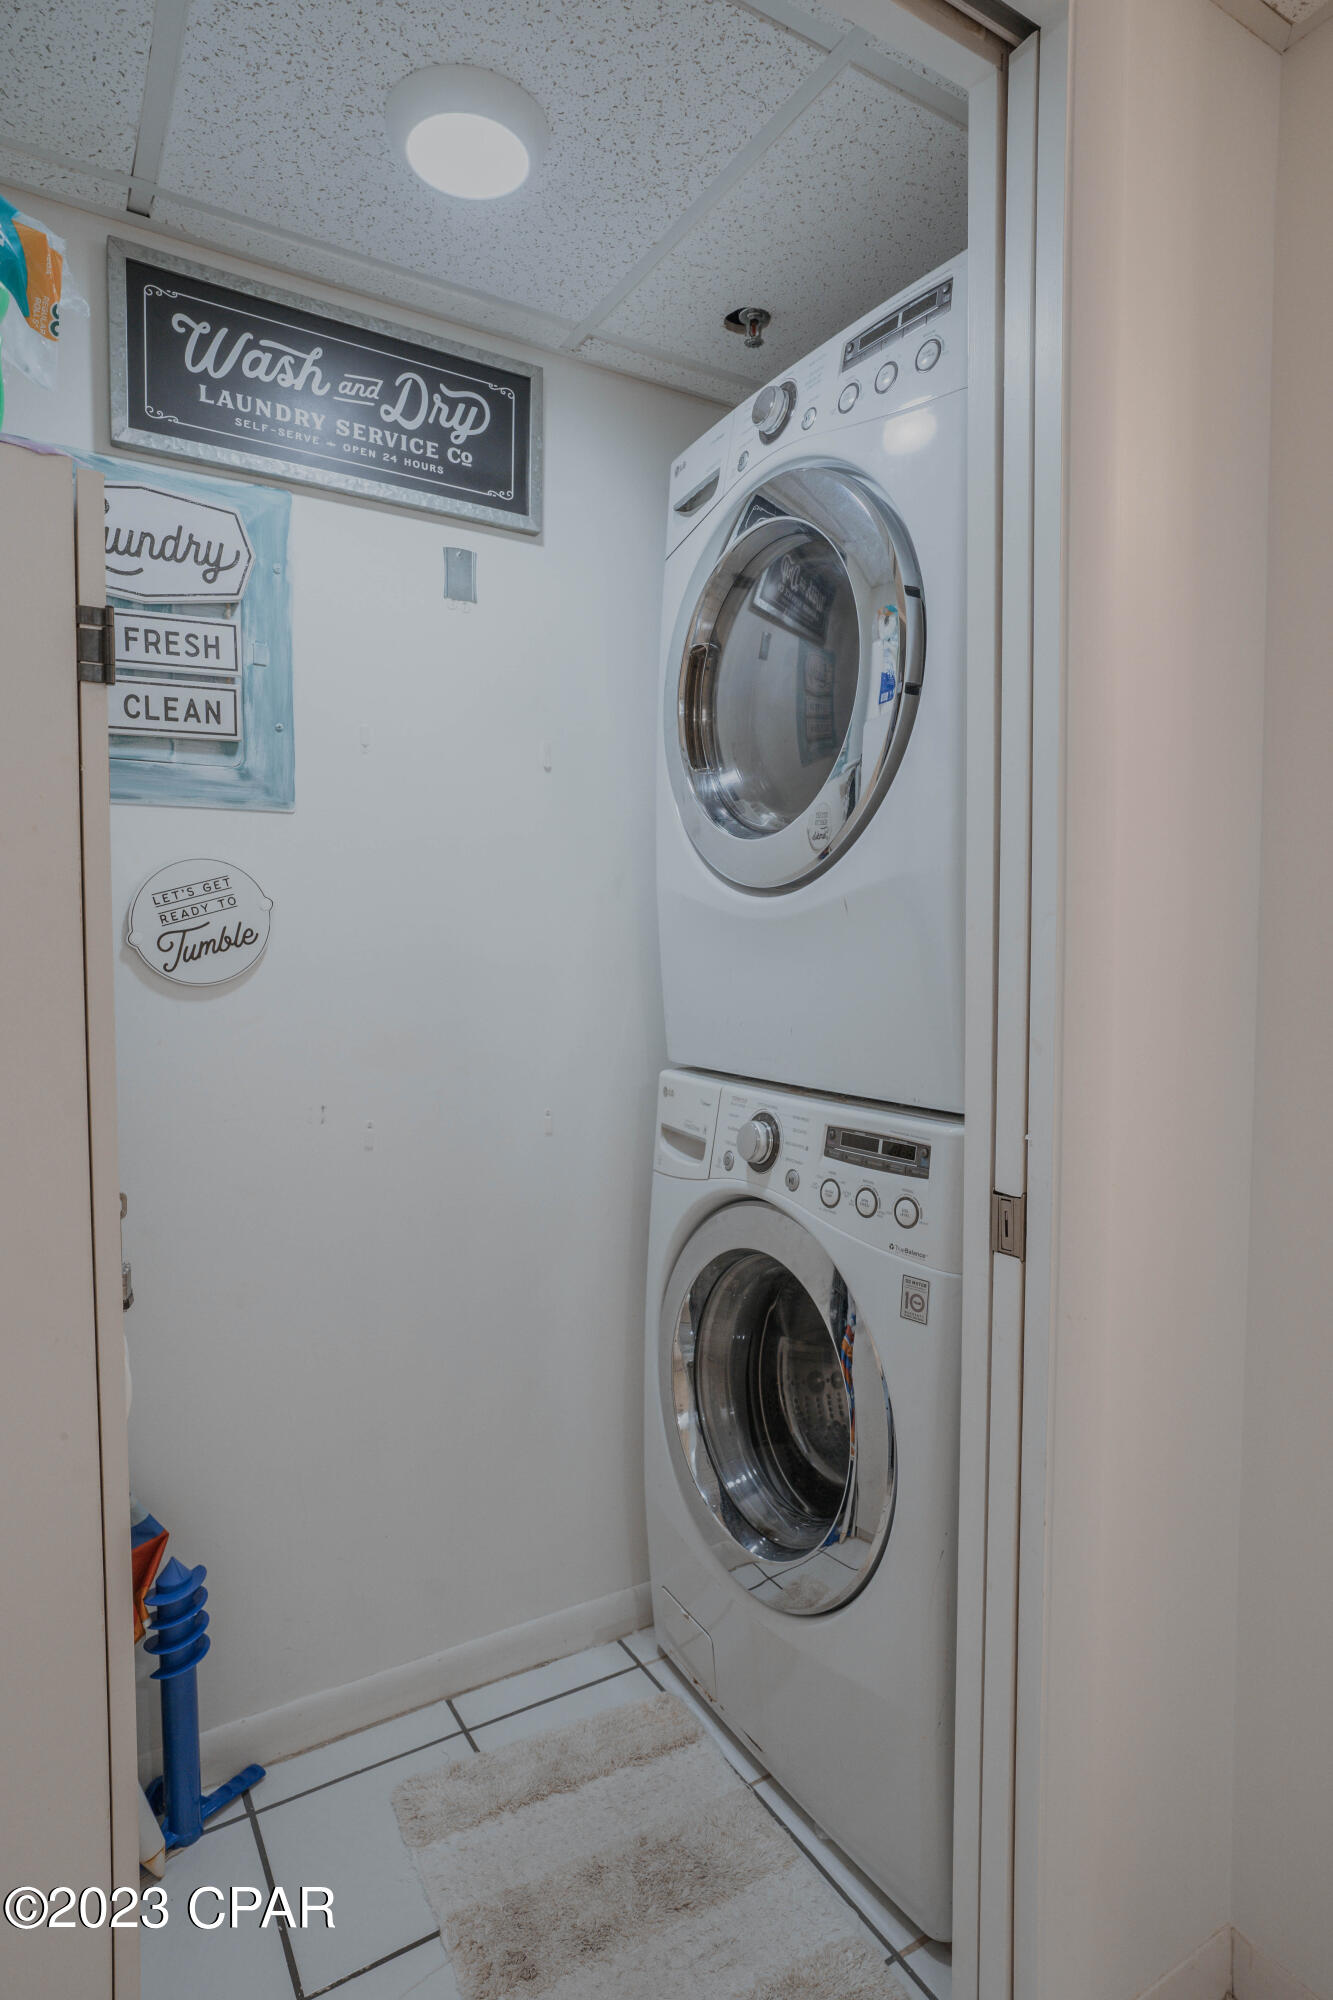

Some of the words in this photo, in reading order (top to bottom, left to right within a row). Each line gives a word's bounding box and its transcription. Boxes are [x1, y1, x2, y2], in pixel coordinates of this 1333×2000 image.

[171, 313, 331, 397] Wash
[338, 377, 381, 402] and
[379, 372, 491, 444] Dry
[198, 384, 326, 431] LAUNDRY
[335, 419, 439, 460] SERVICE
[234, 417, 320, 446] SELF-SERVE
[342, 443, 377, 460] OPEN
[382, 452, 399, 464] 24
[403, 458, 445, 475] HOURS
[104, 520, 240, 584] undry
[123, 626, 221, 660] FRESH
[122, 693, 222, 726] CLEAN
[152, 887, 195, 905] LET'S
[202, 877, 231, 893] GET
[159, 903, 209, 925] READY
[217, 896, 237, 909] TO
[156, 920, 259, 973] Tumble
